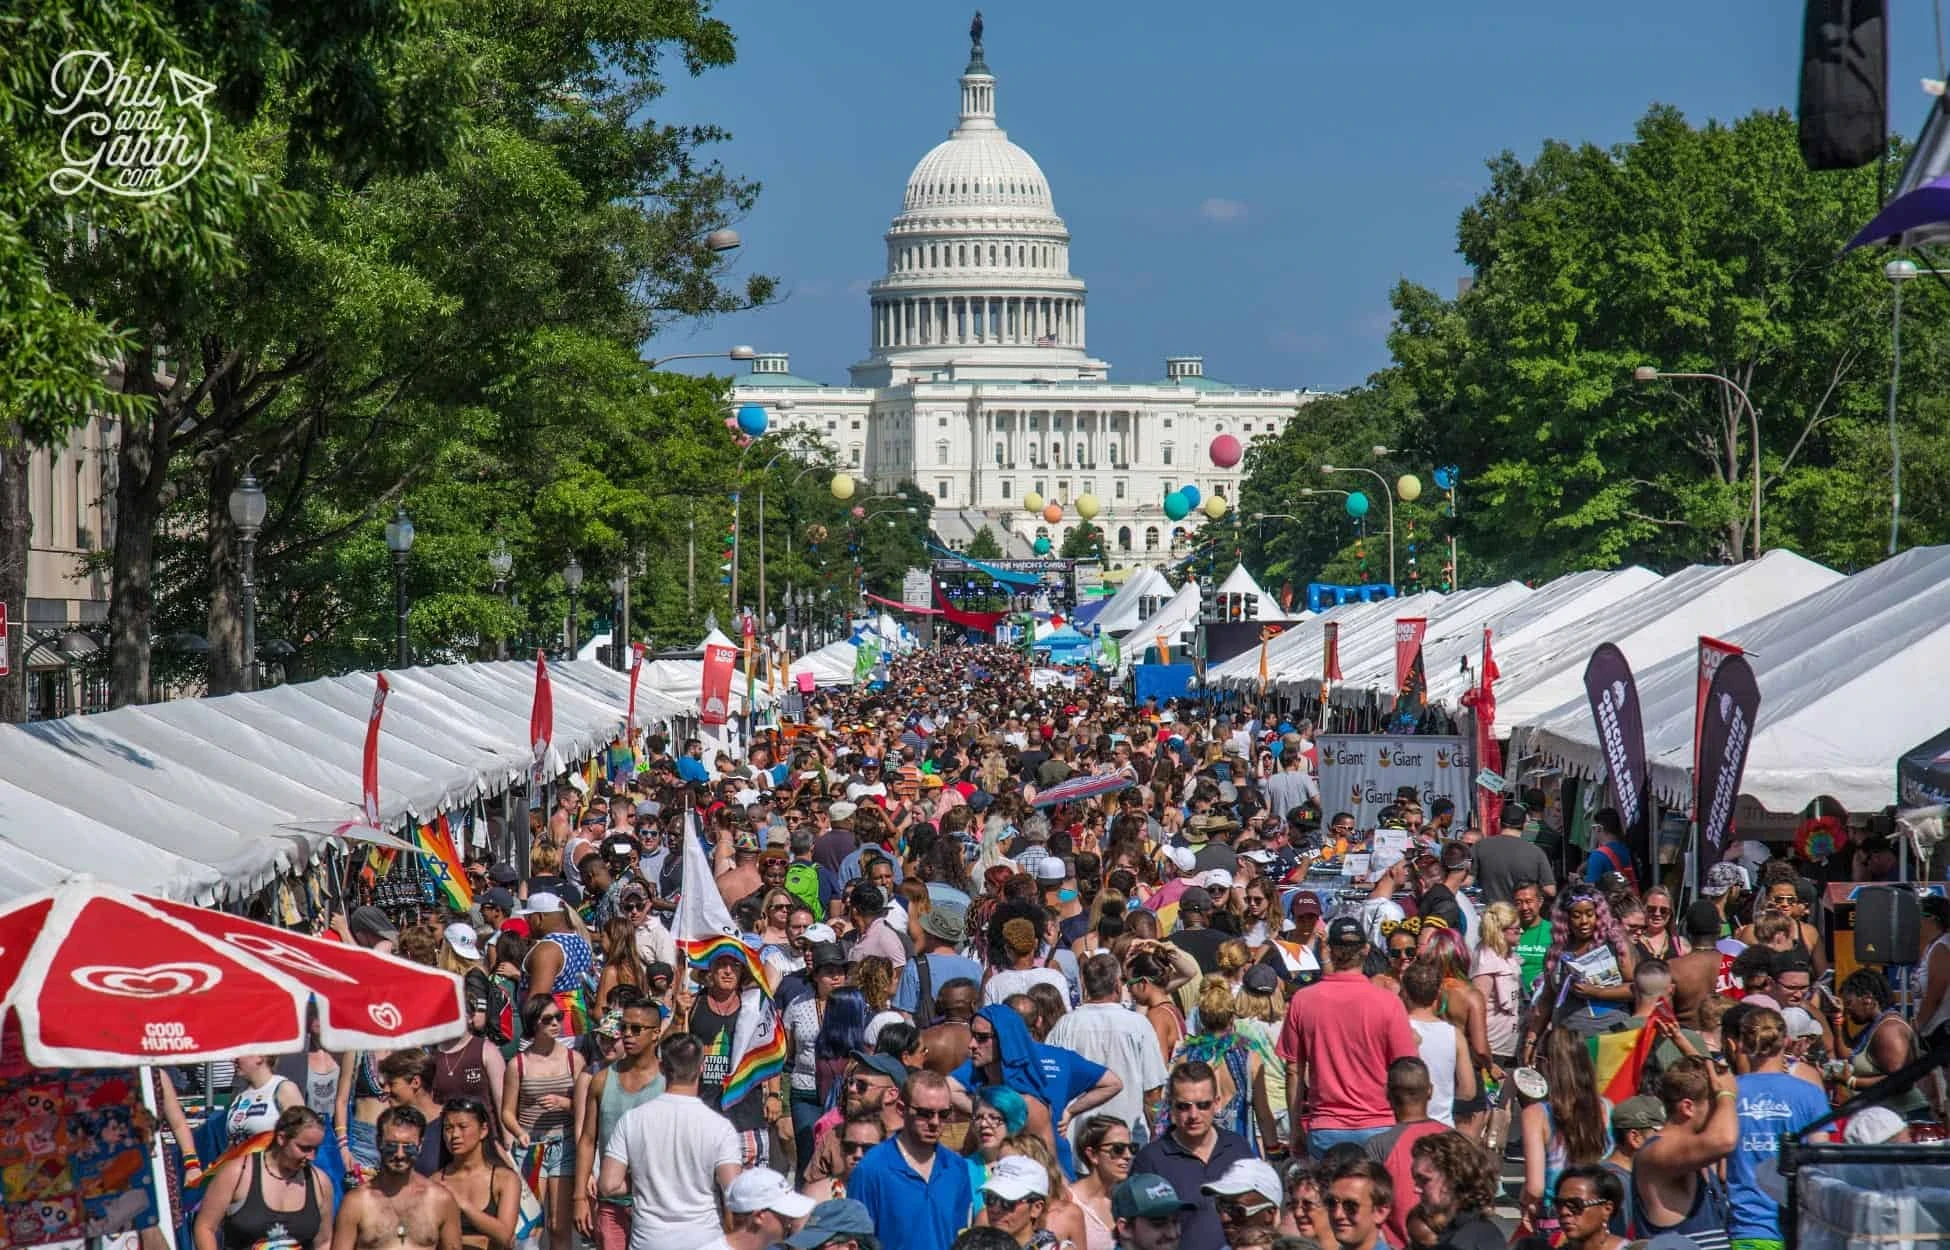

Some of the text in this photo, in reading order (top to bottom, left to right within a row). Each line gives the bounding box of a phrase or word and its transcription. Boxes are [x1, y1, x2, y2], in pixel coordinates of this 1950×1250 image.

[1336, 750, 1365, 766] Giant
[1392, 751, 1423, 767] Giant
[1451, 752, 1471, 768] Gia
[1602, 689, 1641, 825] OFFICIAL PRIDE
[1597, 702, 1634, 831] MERCHANDISE
[1705, 704, 1743, 841] OFFICIAL PRIDE
[1712, 719, 1748, 849] MERCHANDISE
[1365, 788, 1393, 804] Giant
[145, 1022, 185, 1037] GOOD
[141, 1036, 196, 1051] HUMOR
